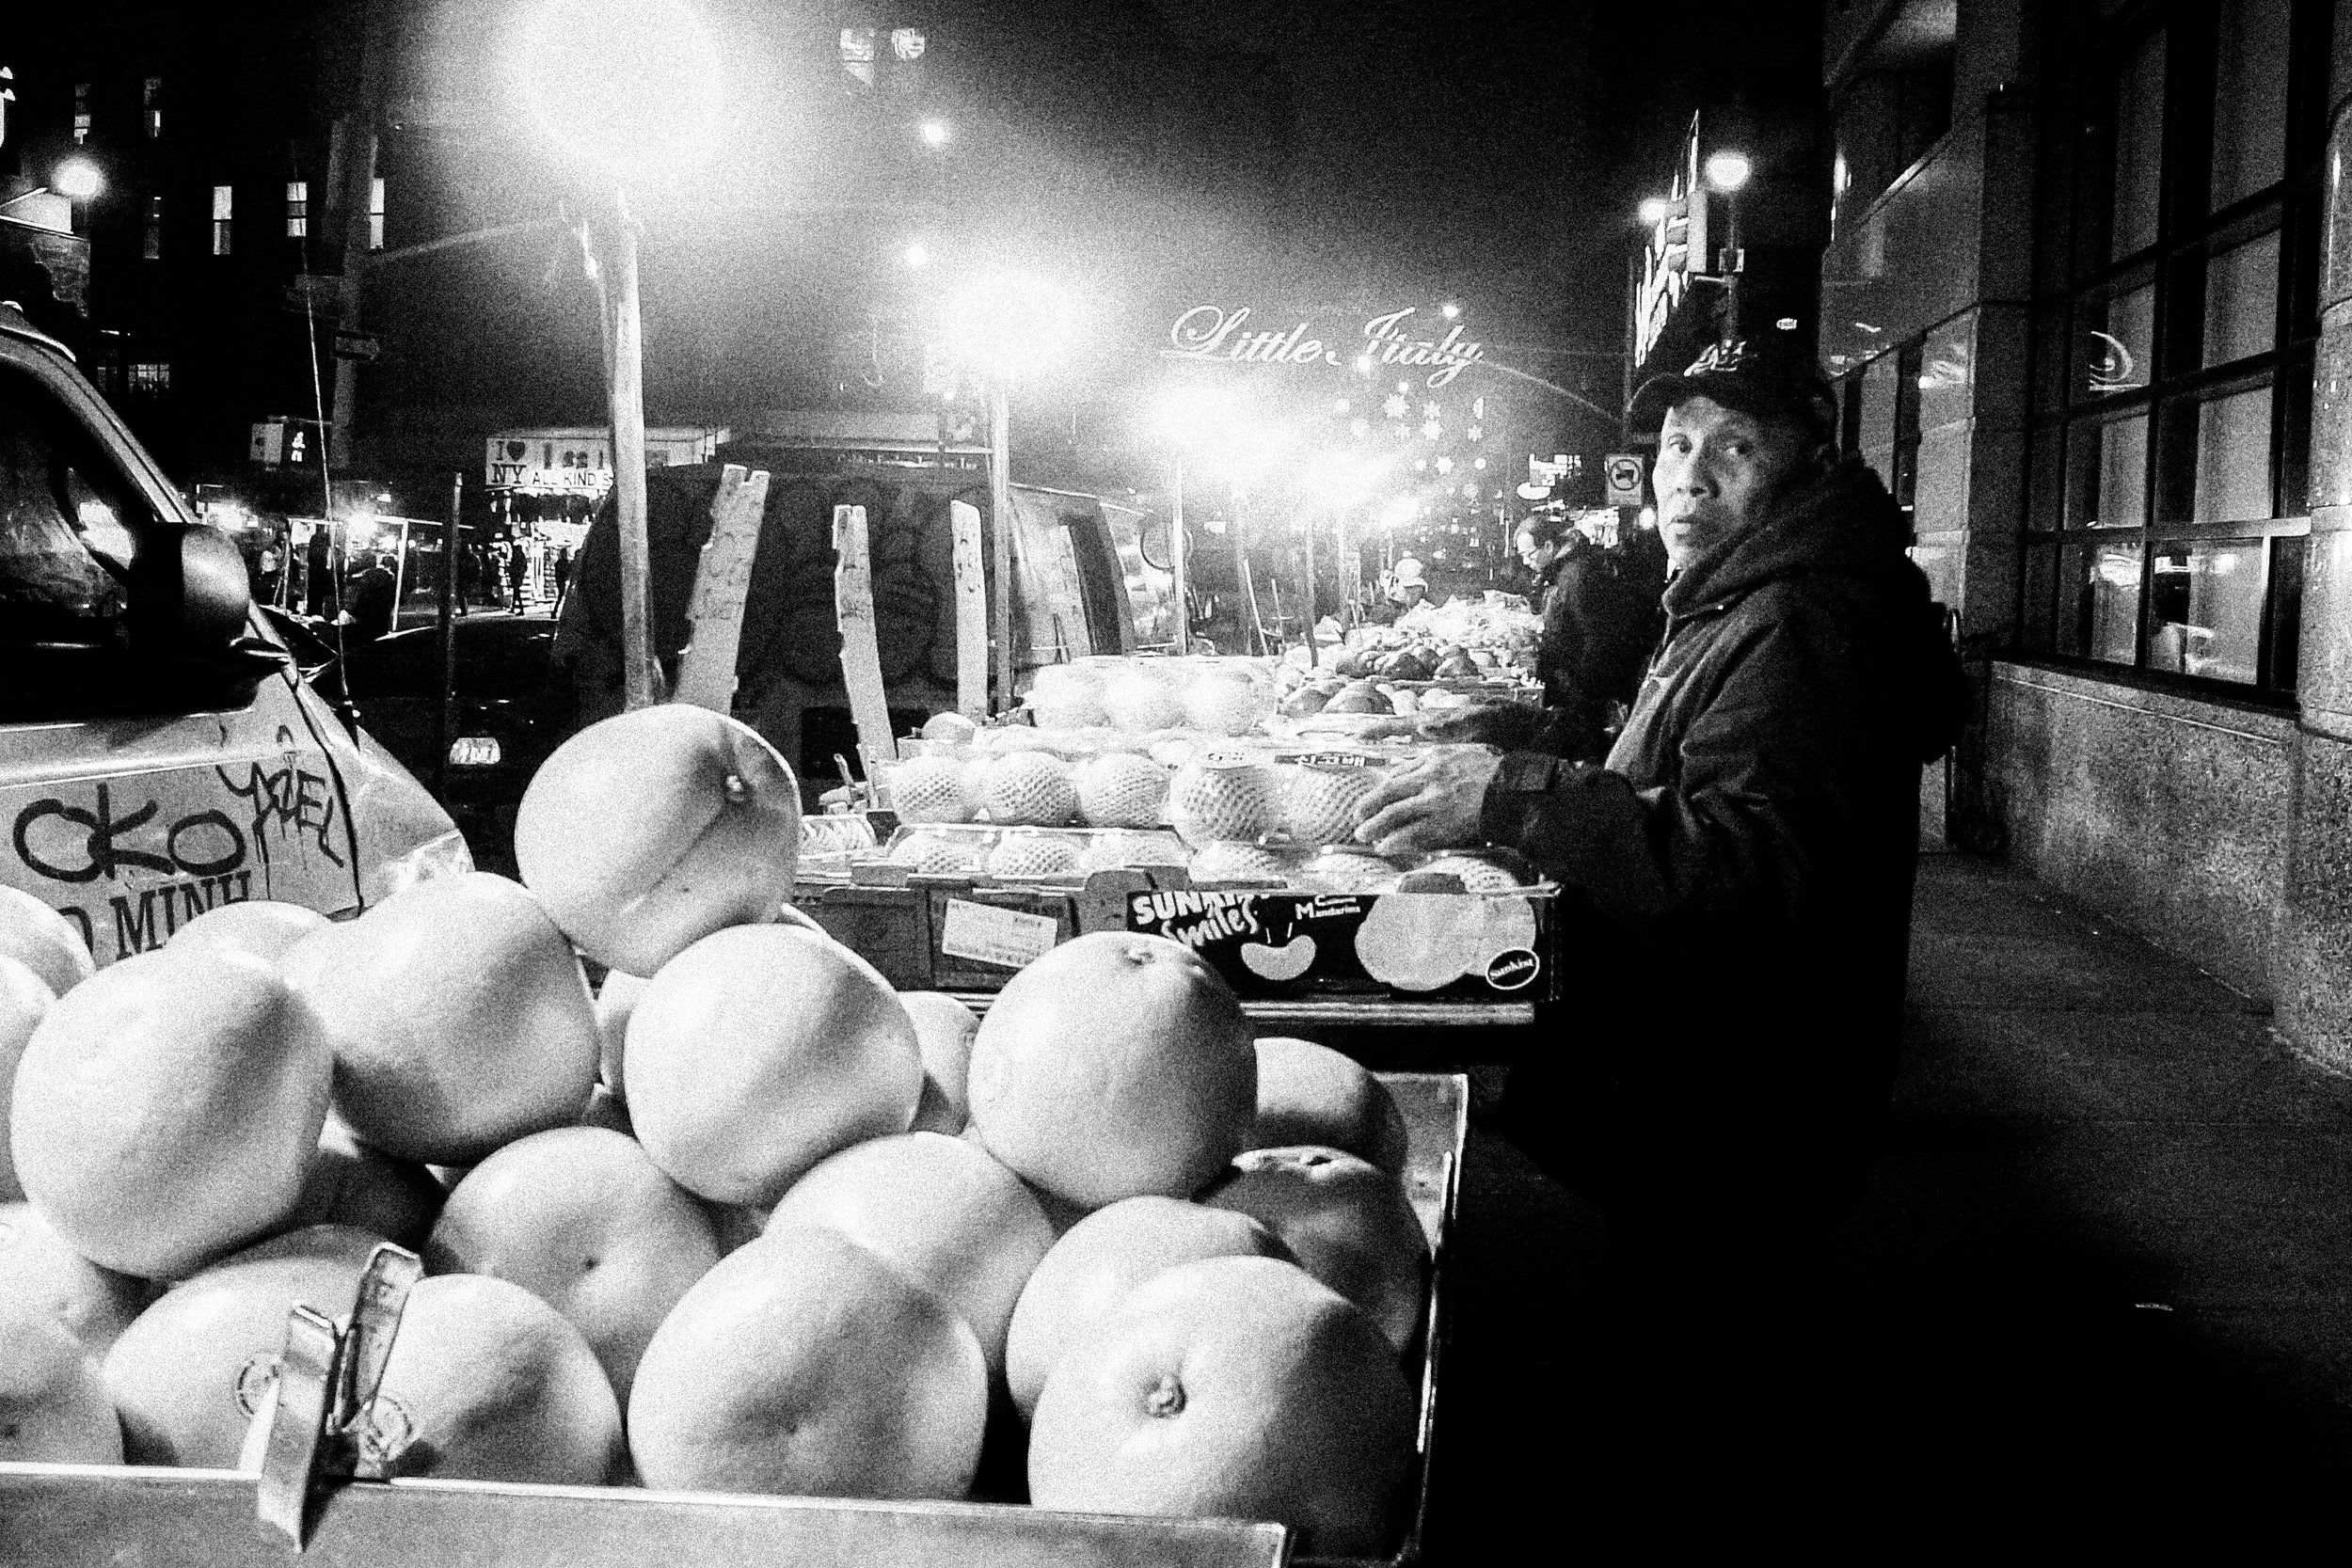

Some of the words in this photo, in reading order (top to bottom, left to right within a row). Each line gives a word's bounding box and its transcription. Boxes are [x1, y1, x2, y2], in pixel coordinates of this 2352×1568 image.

[1160, 306, 1323, 364] Little
[1326, 306, 1485, 388] Italy
[491, 463, 527, 484] NY
[496, 440, 504, 461] I
[109, 870, 251, 961] MINH
